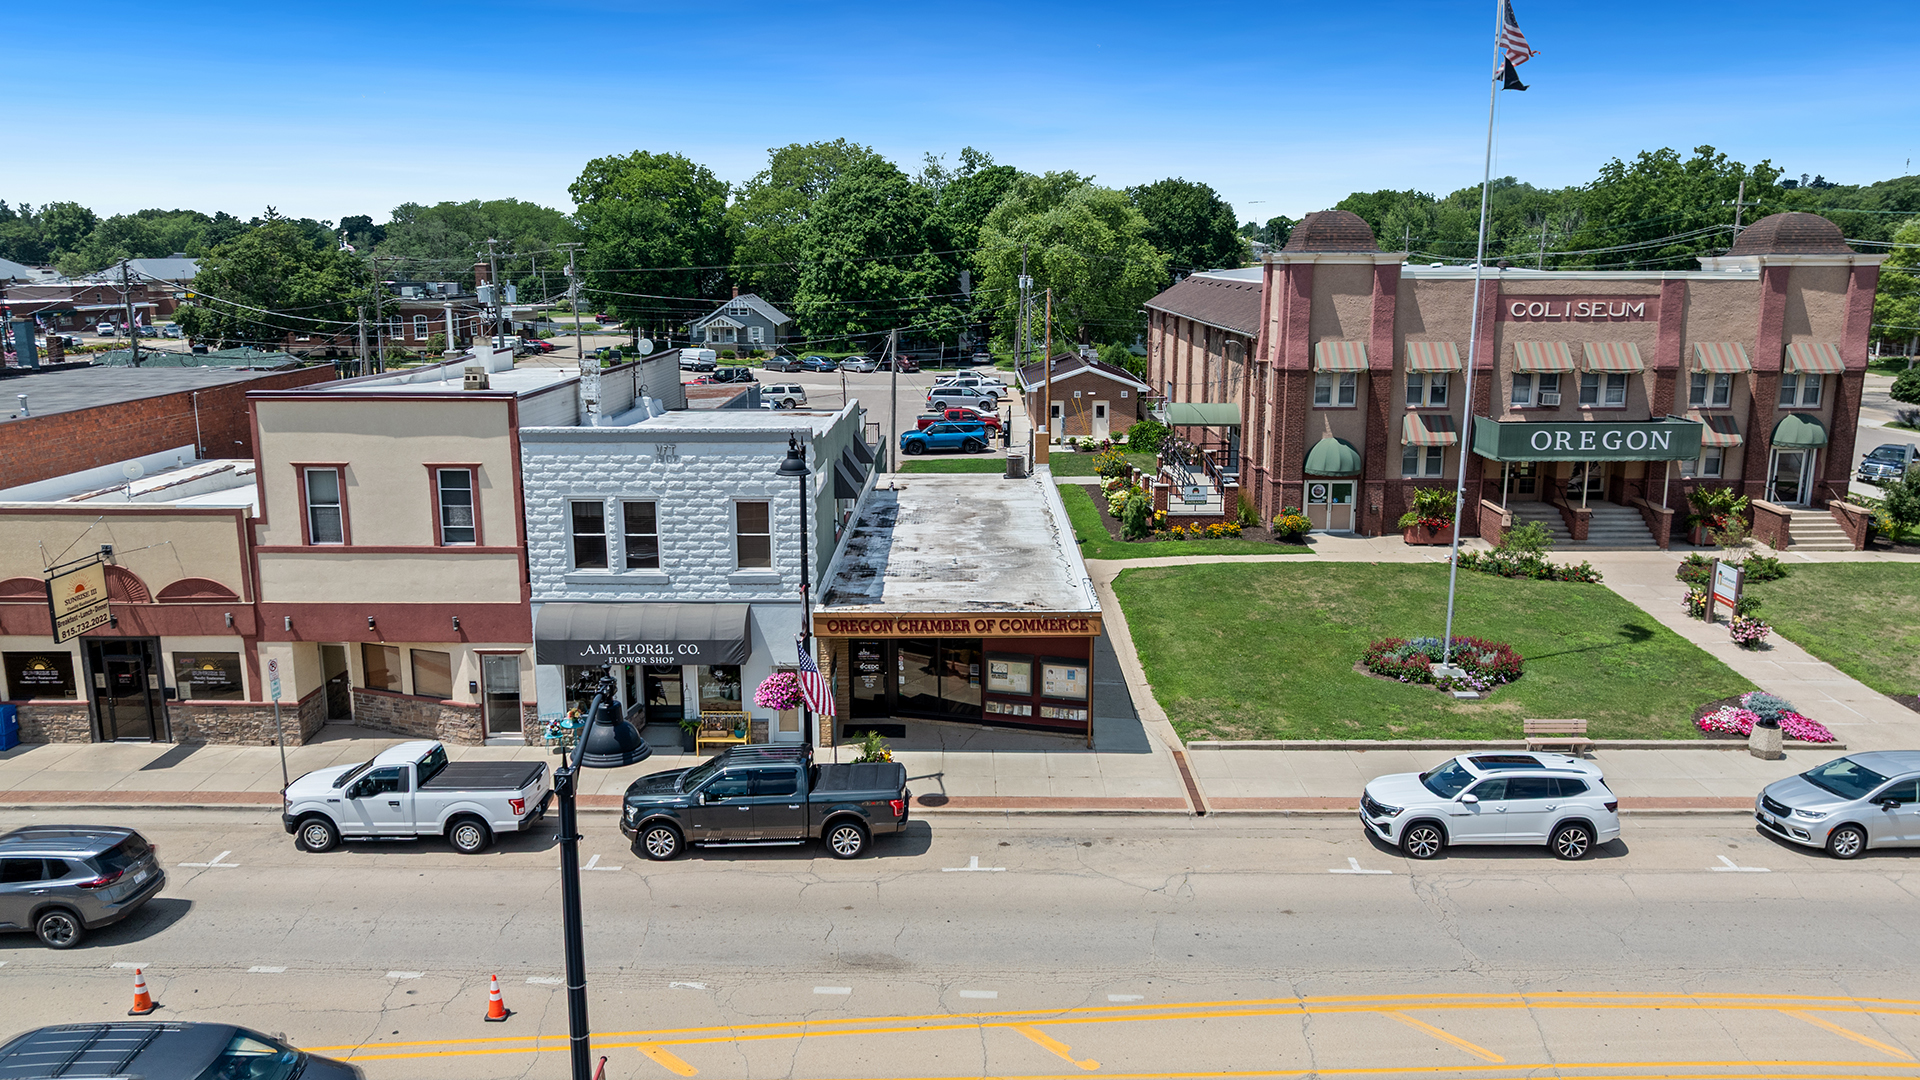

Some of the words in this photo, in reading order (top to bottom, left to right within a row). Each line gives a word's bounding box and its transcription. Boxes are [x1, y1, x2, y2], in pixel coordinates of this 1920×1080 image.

[1510, 301, 1645, 317] COLISEUM
[1530, 430, 1672, 451] OREGON
[57, 615, 78, 628] Breakfast
[95, 603, 107, 613] Dinner
[61, 613, 107, 639] 815.732.2022
[826, 619, 894, 632] OREGON
[896, 619, 971, 632] CHAMBER
[974, 619, 996, 631] OF
[999, 619, 1089, 632] COMMERCE
[580, 644, 615, 657] A.M.
[677, 644, 700, 655] CO.
[649, 656, 675, 664] SHOP
